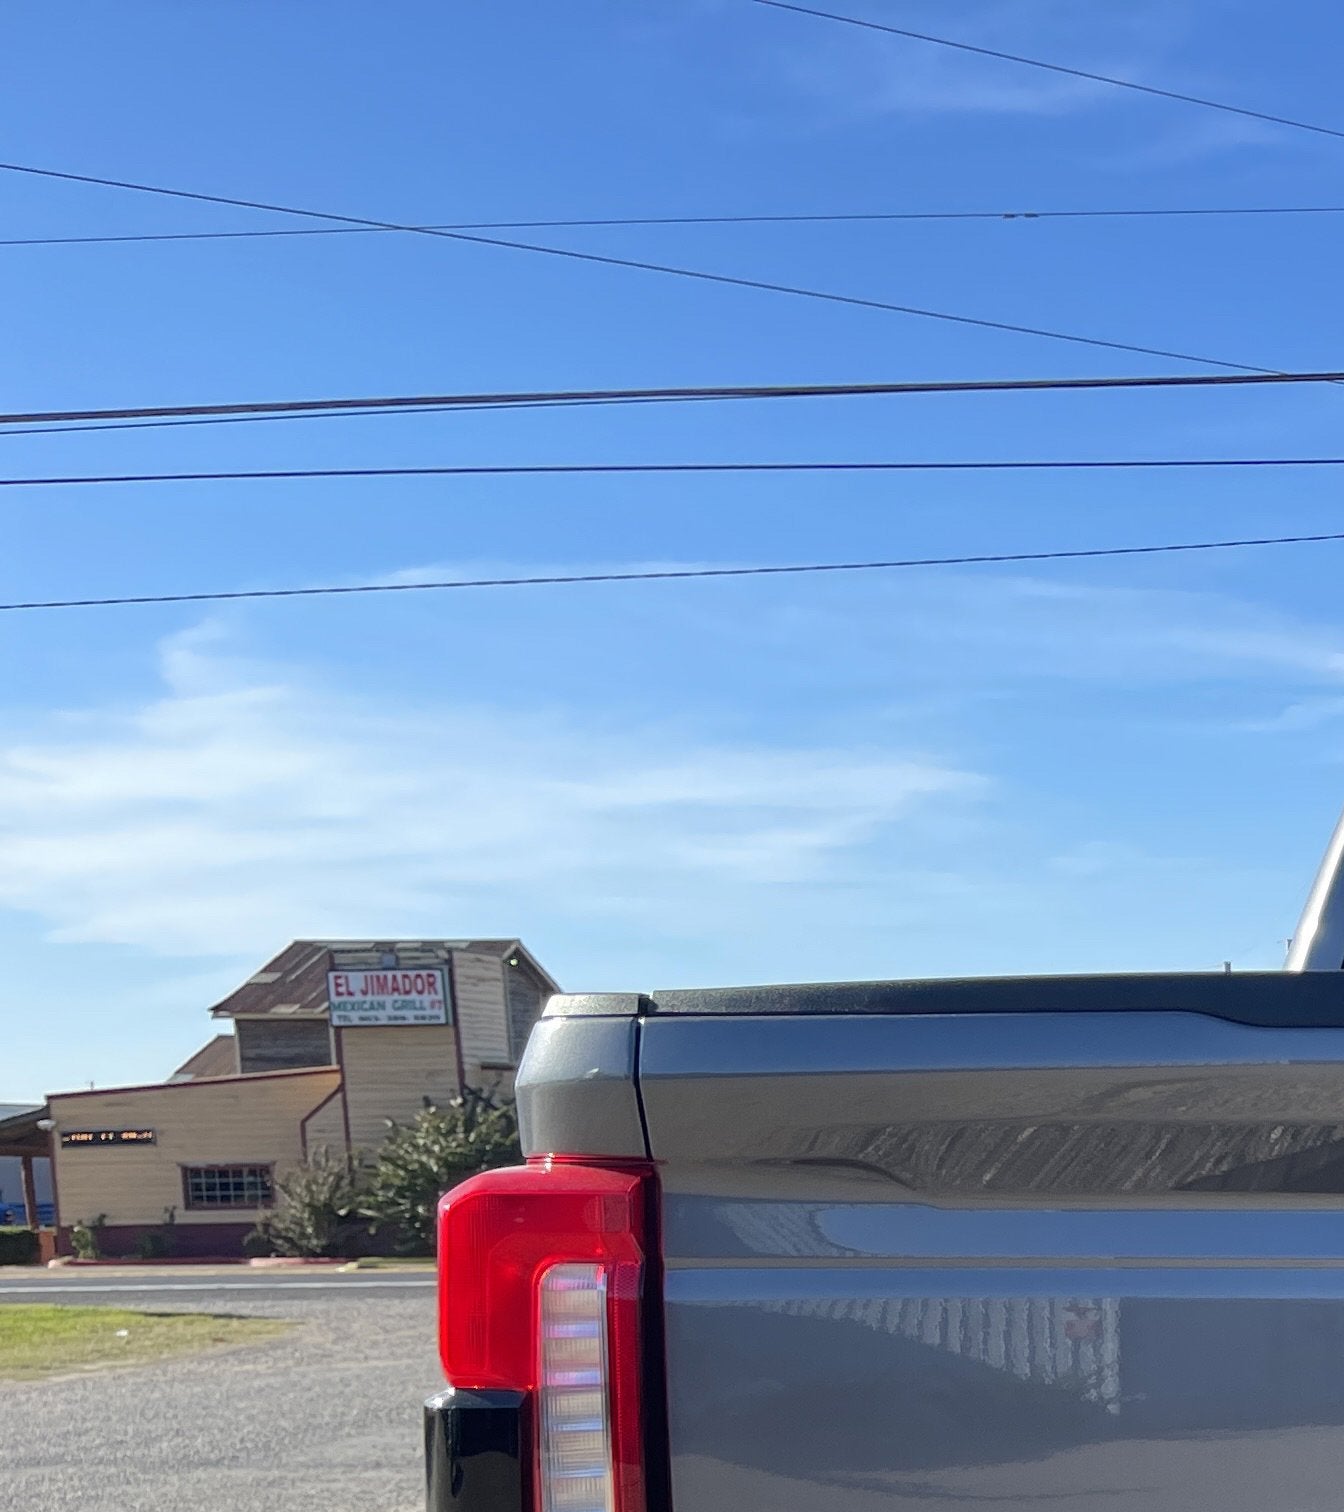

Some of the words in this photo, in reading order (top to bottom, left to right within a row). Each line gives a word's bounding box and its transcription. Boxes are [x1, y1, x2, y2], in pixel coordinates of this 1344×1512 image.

[334, 975, 355, 996] EL
[360, 973, 438, 996] JIMADOR
[331, 1001, 386, 1012] MEXICAN
[391, 999, 426, 1011] GRILL
